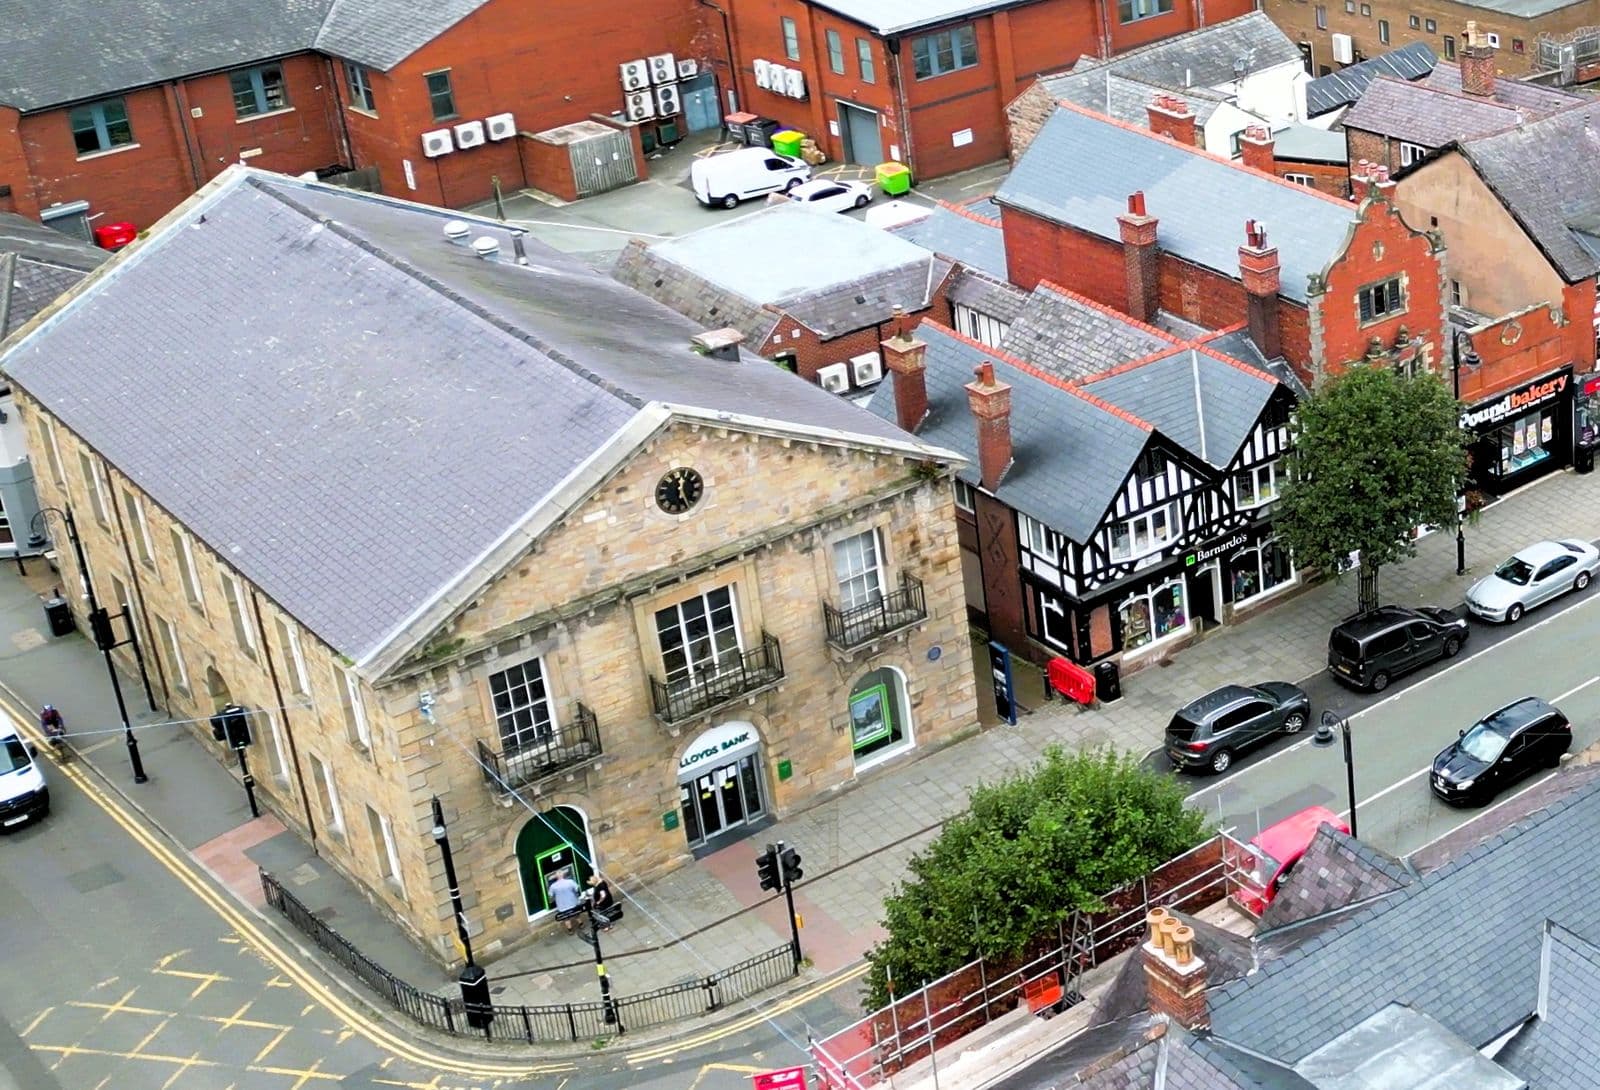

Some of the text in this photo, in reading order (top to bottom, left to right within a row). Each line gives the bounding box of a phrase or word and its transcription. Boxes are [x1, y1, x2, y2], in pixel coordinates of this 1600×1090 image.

[1197, 533, 1248, 562] Barnardo's
[680, 732, 750, 768] LLOYDS BANK
